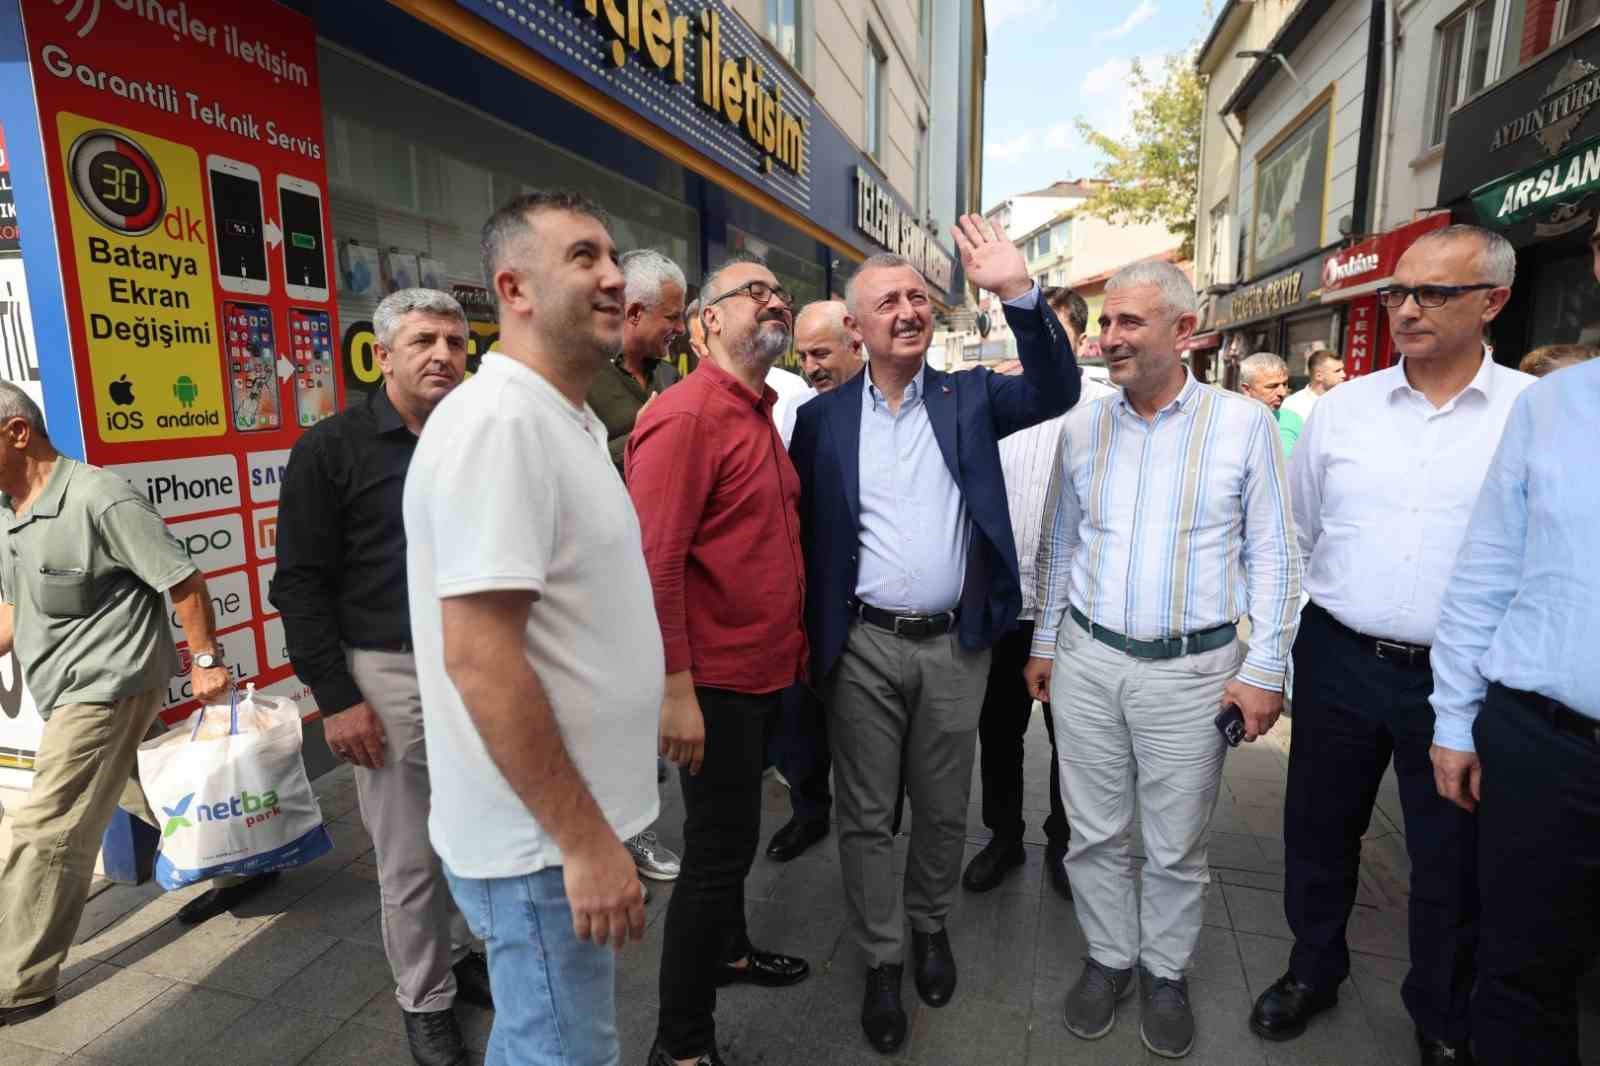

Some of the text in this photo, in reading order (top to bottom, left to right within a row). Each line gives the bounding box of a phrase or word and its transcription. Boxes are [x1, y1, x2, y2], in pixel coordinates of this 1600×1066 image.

[223, 25, 308, 87] iletişim
[41, 44, 321, 160] Garantili Teknik Servis
[700, 7, 804, 175] iletişim
[1489, 104, 1547, 152] AYDIN
[102, 163, 140, 205] 30
[164, 206, 205, 244] dk
[88, 236, 198, 280] Batarya
[108, 276, 190, 309] Ekran
[90, 313, 211, 348] Değişimi
[106, 411, 144, 430] iOS
[157, 410, 219, 428] android
[146, 474, 233, 505] iPhone
[196, 789, 279, 822] netba
[245, 806, 281, 828] park
